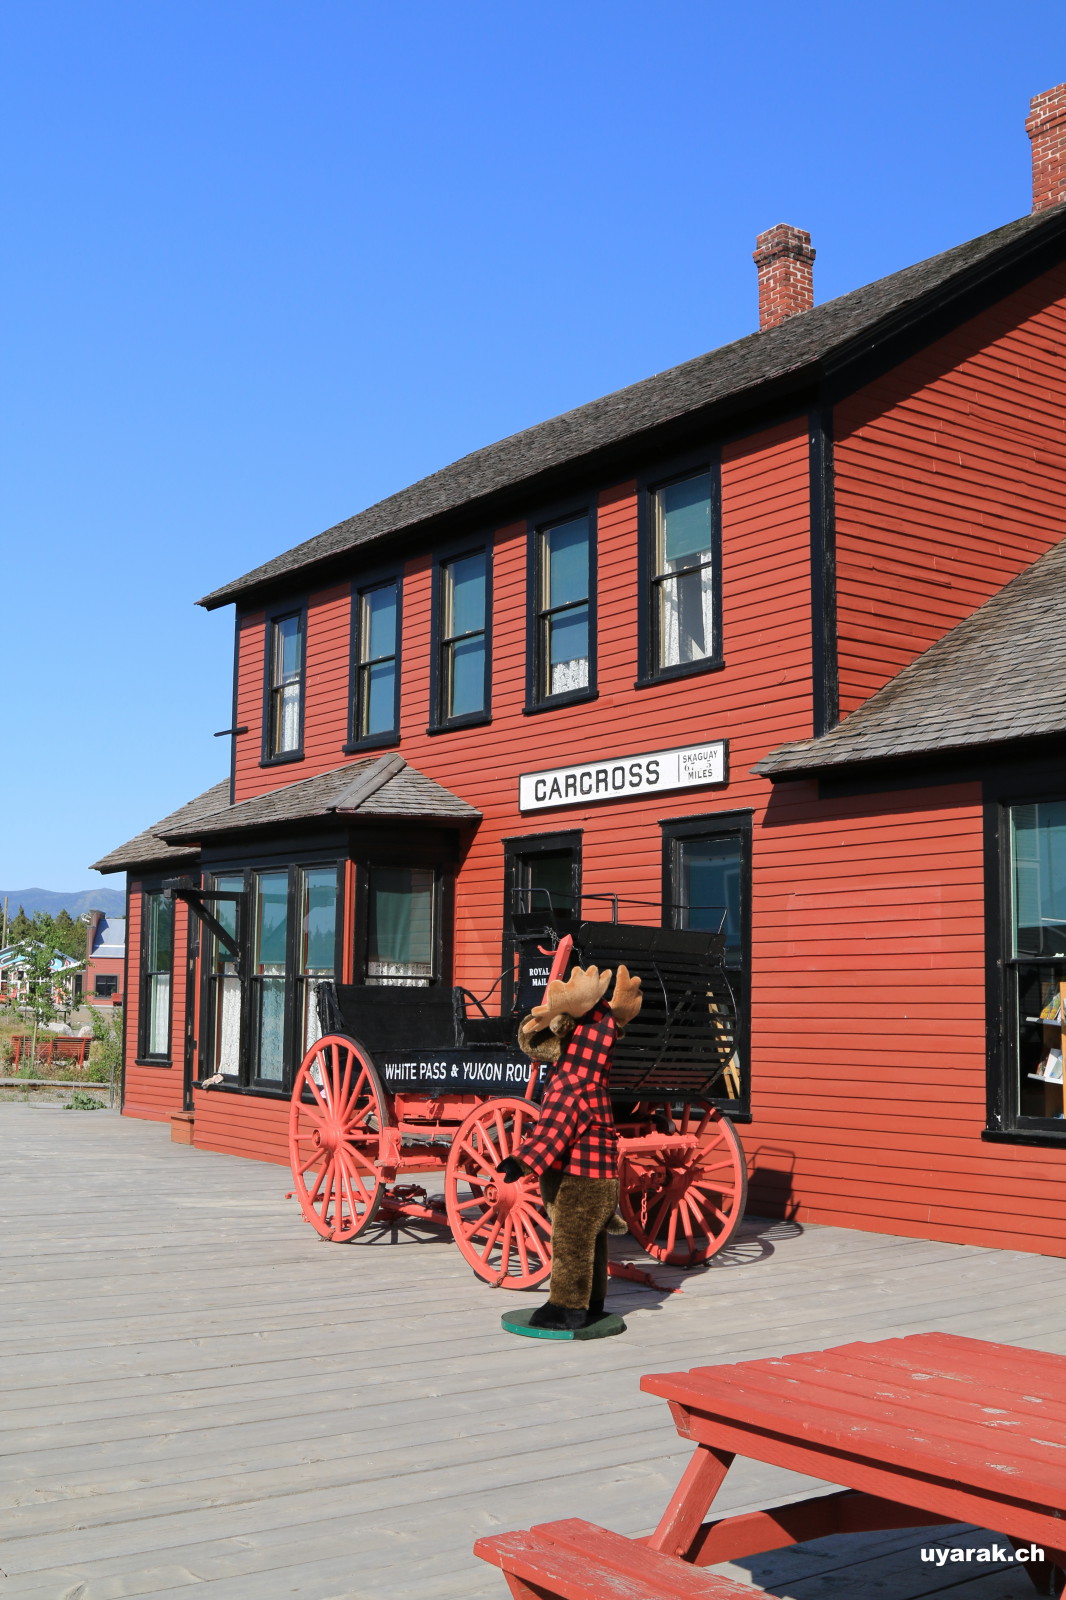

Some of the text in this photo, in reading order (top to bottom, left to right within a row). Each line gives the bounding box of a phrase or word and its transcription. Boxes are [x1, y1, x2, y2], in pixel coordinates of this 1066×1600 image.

[683, 750, 718, 763] SKAGUAY
[688, 769, 713, 780] MILES
[534, 760, 660, 802] CARCROSS
[529, 968, 550, 976] ROYAL
[532, 978, 548, 986] MAIL
[385, 1062, 548, 1083] WHITE PASS & YUKON ROUE
